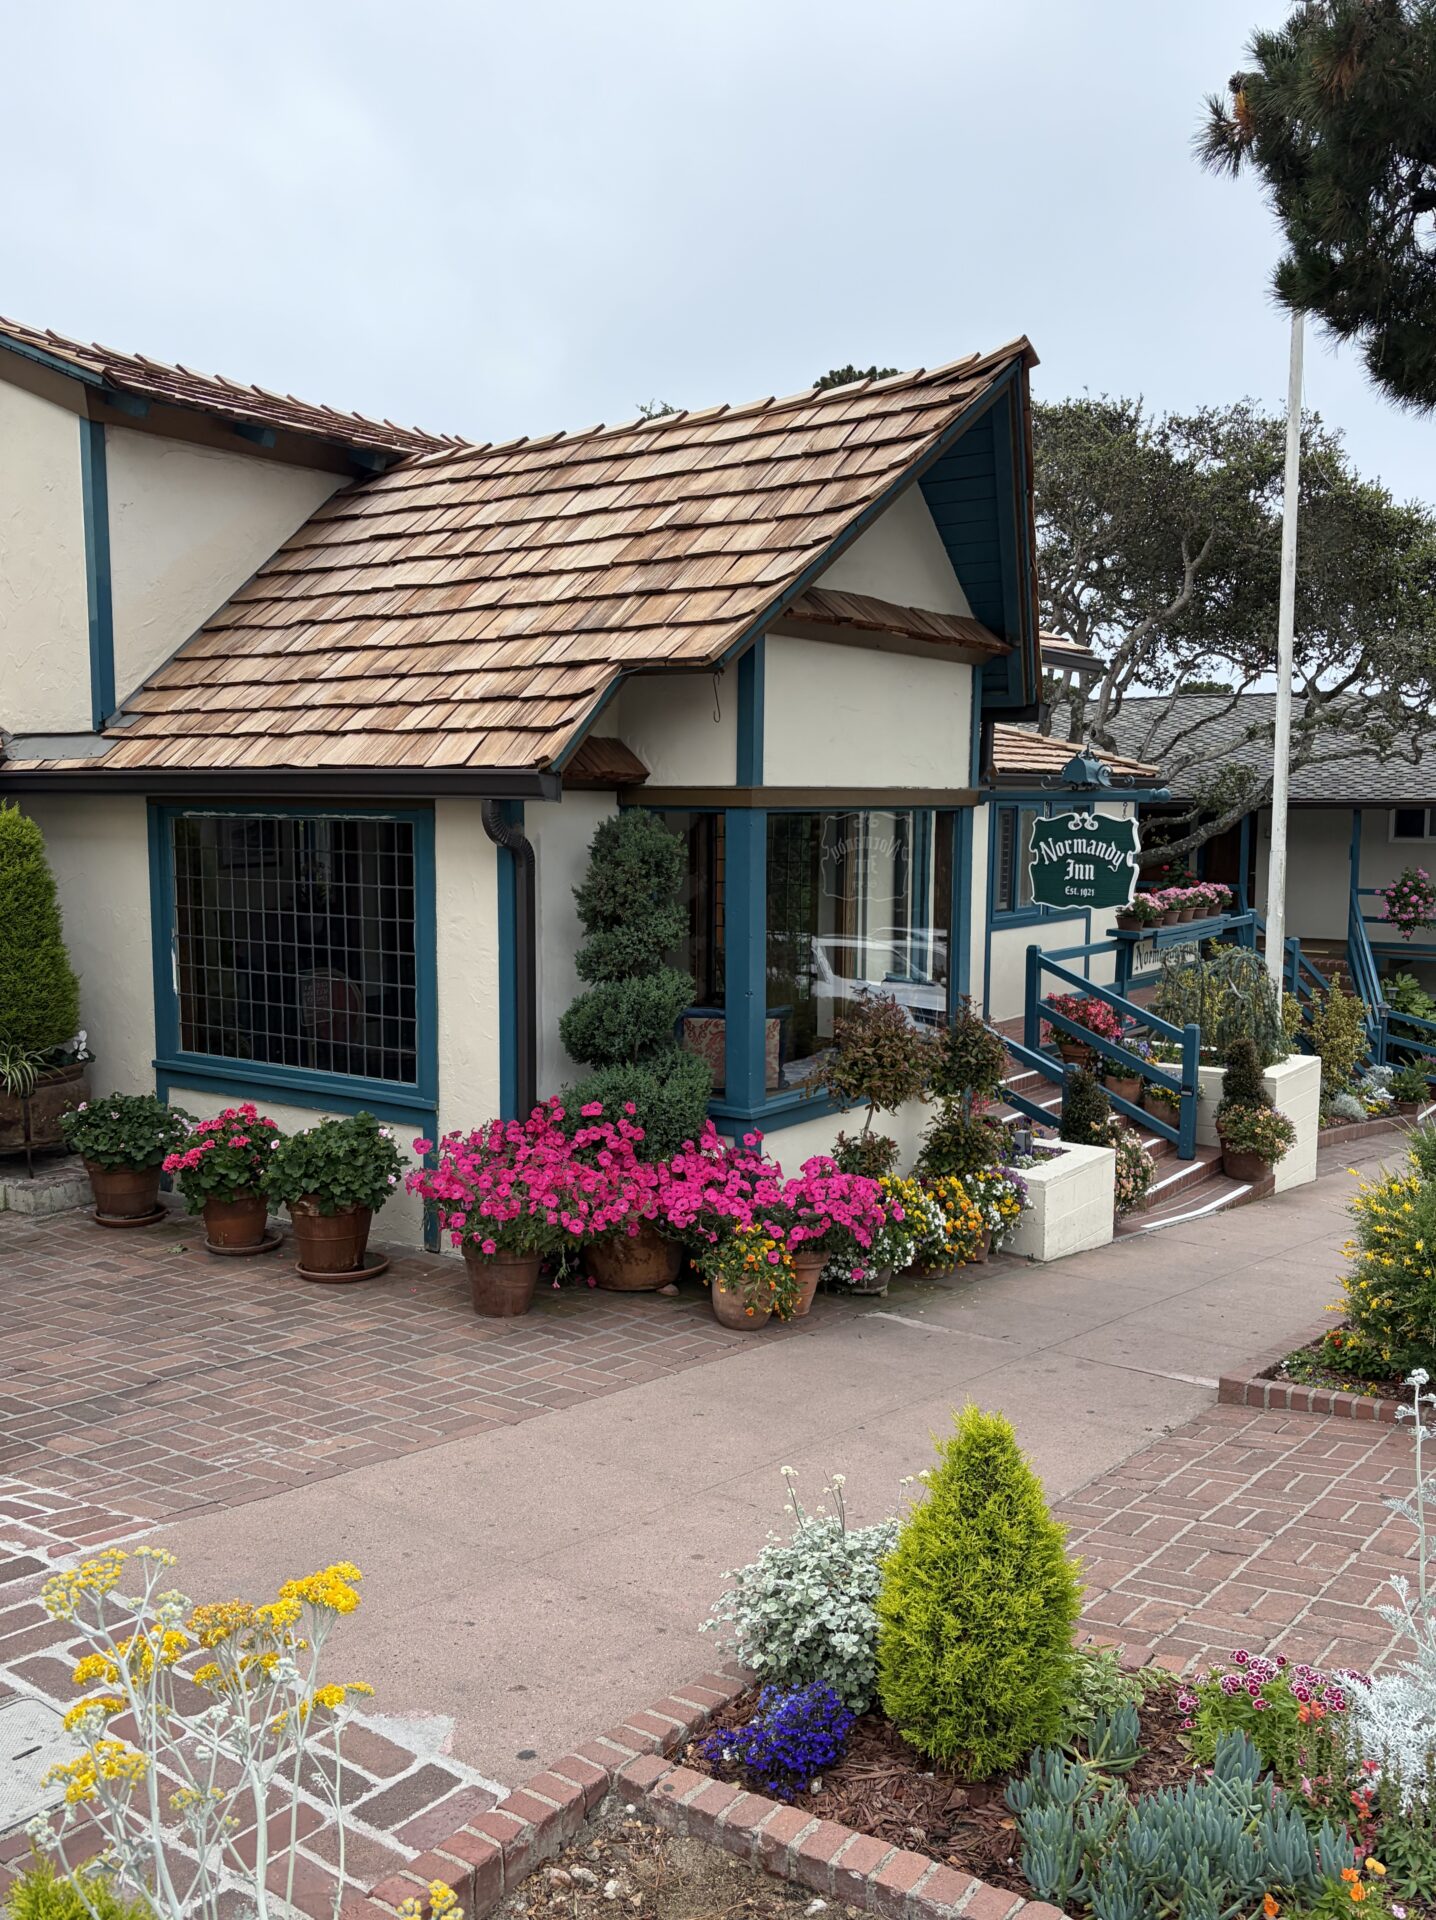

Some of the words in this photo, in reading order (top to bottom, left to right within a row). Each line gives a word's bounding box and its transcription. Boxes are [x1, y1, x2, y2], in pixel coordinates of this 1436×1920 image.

[1039, 837, 1125, 872] Normandy
[1064, 859, 1095, 881] Inn
[1065, 885, 1079, 896] Est.
[1080, 888, 1095, 898] 1921
